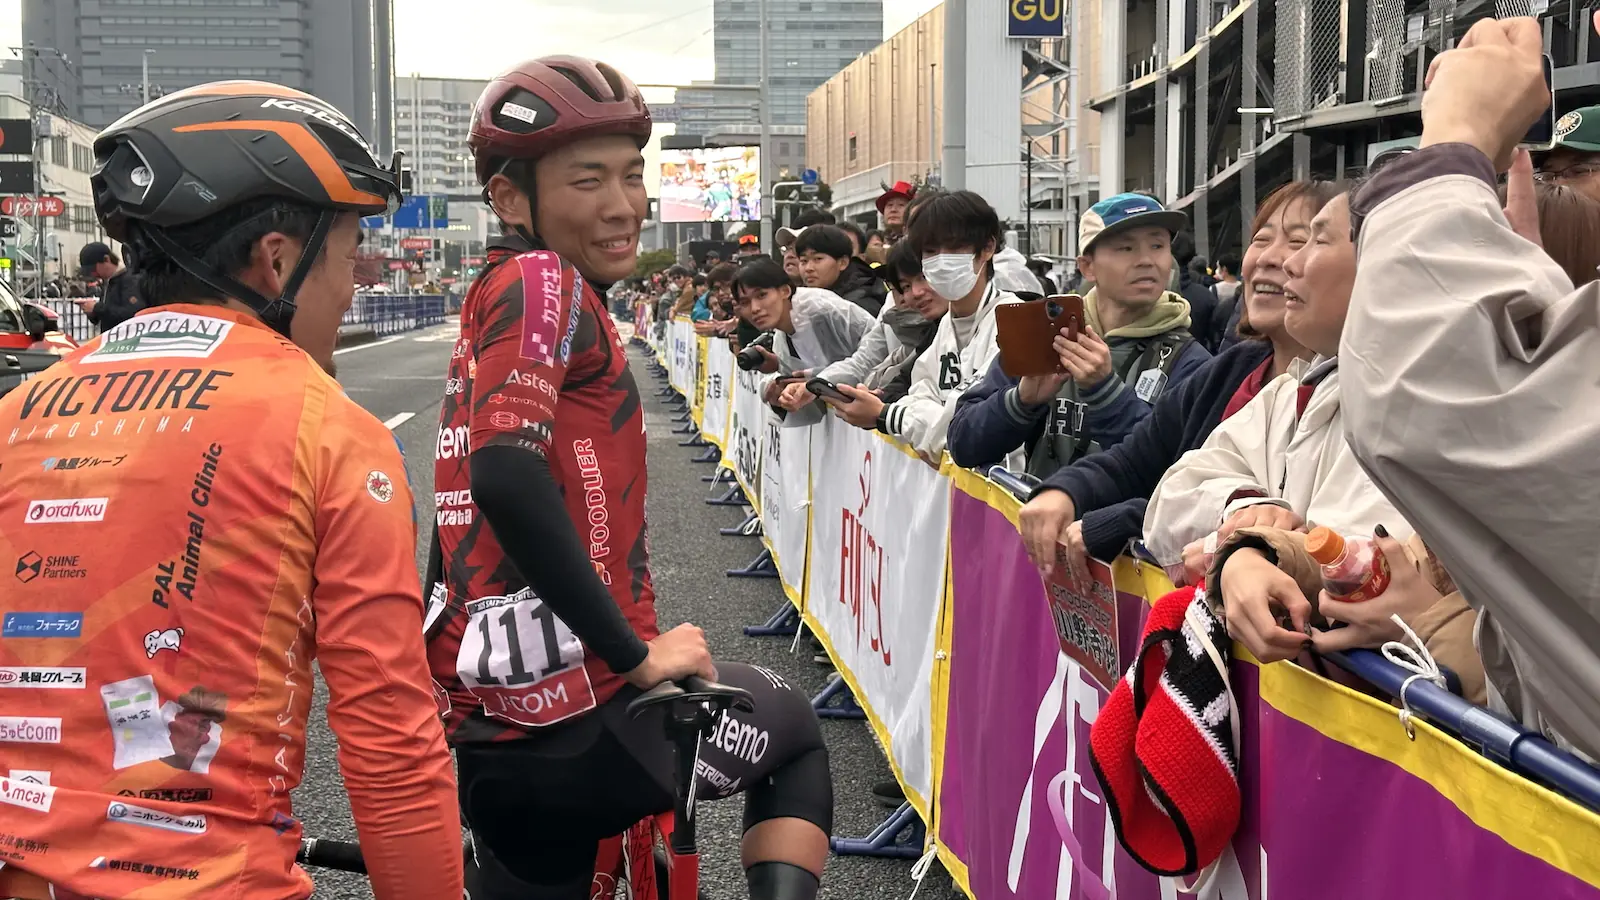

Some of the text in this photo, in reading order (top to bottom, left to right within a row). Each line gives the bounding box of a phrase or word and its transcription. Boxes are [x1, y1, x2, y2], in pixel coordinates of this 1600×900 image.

[1011, 0, 1060, 21] GU
[541, 267, 561, 328] カンセキ
[108, 318, 227, 343] HIROTANI
[20, 368, 235, 420] VICTOIRE
[509, 396, 538, 408] TOYOTA
[8, 416, 194, 445] HIROSHIMA
[175, 442, 223, 602] Animal Clinic
[42, 567, 87, 579] Partners
[45, 555, 81, 567] SHINE
[152, 560, 176, 610] PAL
[36, 619, 80, 631] フォーテック
[475, 602, 569, 686] 111
[19, 671, 83, 683] 長岡グループ
[705, 708, 769, 764] stemo
[696, 758, 733, 791] ERIDA
[131, 810, 206, 829] ニホンケミカル
